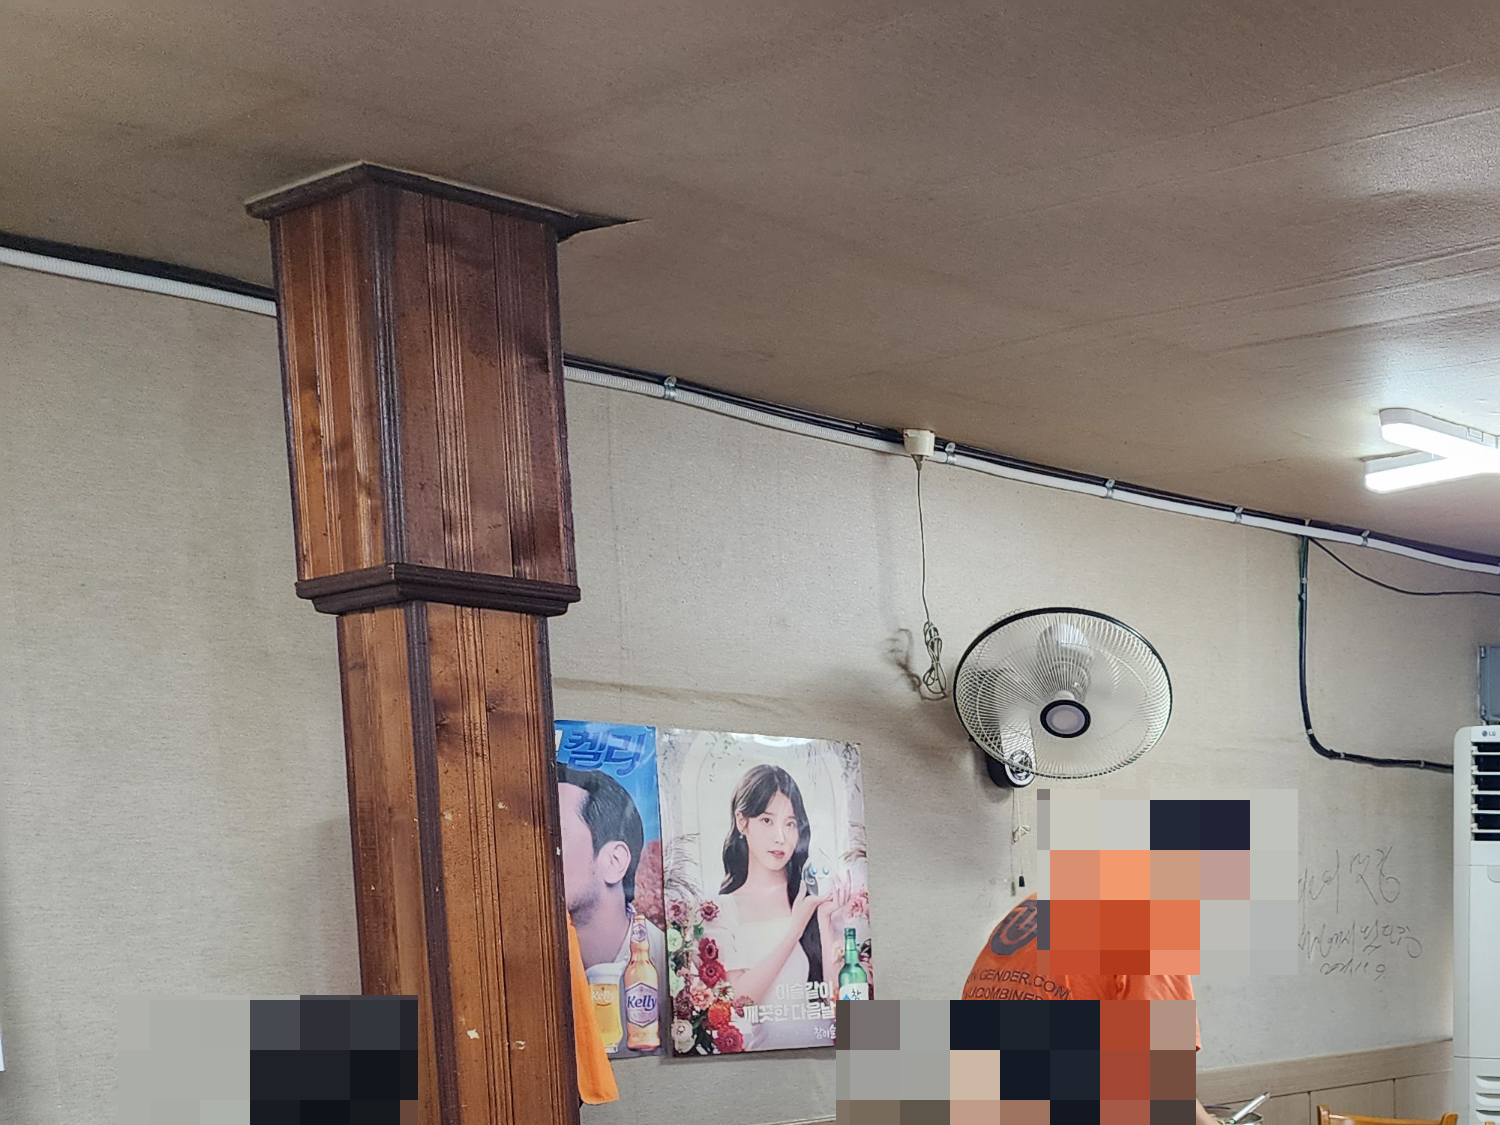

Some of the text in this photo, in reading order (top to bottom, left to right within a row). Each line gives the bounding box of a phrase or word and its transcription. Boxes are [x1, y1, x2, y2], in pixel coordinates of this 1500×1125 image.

[564, 730, 646, 776] 켈리
[776, 981, 834, 1000] 이슬같이
[627, 995, 657, 1012] Kelly
[791, 1001, 836, 1021] 다음날
